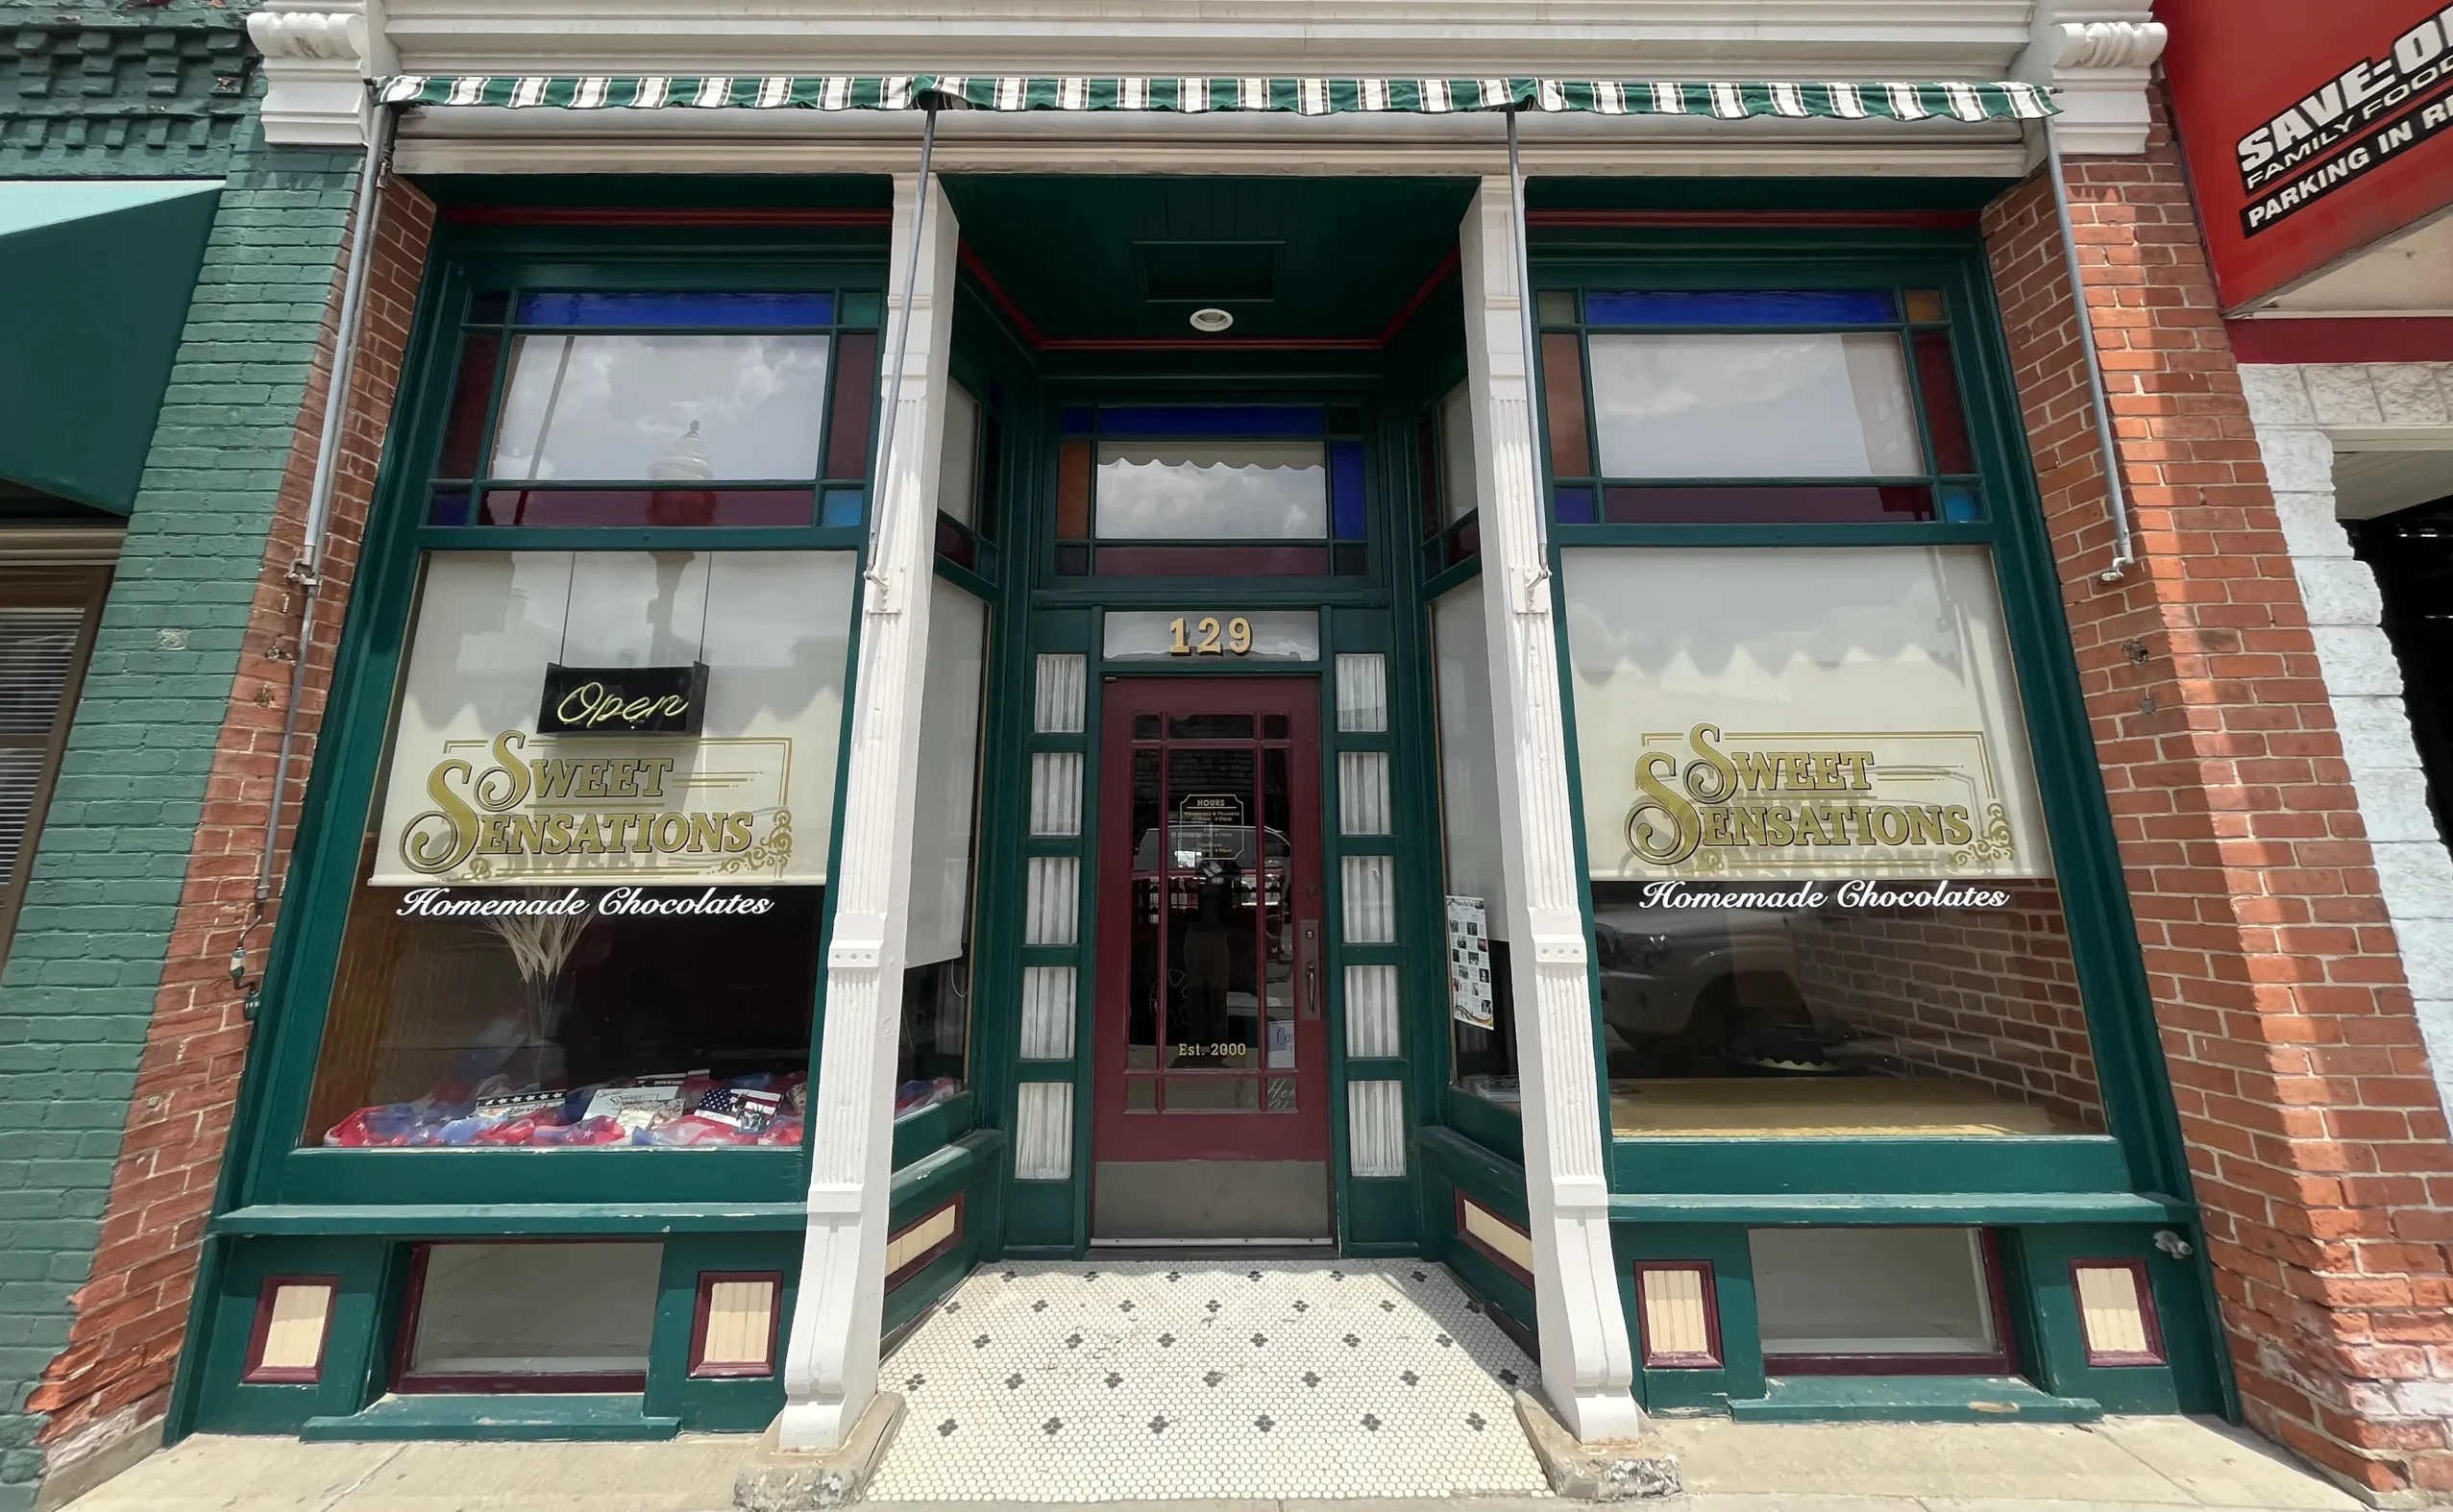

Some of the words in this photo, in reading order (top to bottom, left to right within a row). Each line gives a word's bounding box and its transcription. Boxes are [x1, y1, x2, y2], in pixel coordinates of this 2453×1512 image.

[2245, 114, 2354, 189] FAMILY
[2248, 147, 2370, 228] PARKING
[2377, 120, 2415, 154] IN
[1169, 617, 1253, 657] 129
[556, 681, 689, 728] Open
[474, 730, 675, 812] SWEET
[1682, 723, 1875, 805] SWEET
[399, 759, 753, 874] SENSATIONS
[1624, 751, 1973, 866] SENSATIONS
[396, 887, 591, 916] Homemade
[597, 886, 775, 915] Chocolates
[1638, 880, 1828, 909] Homemade
[1836, 880, 2011, 909] Chocolates
[1178, 1043, 1205, 1056] Est.
[1211, 1042, 1246, 1056] 2000
